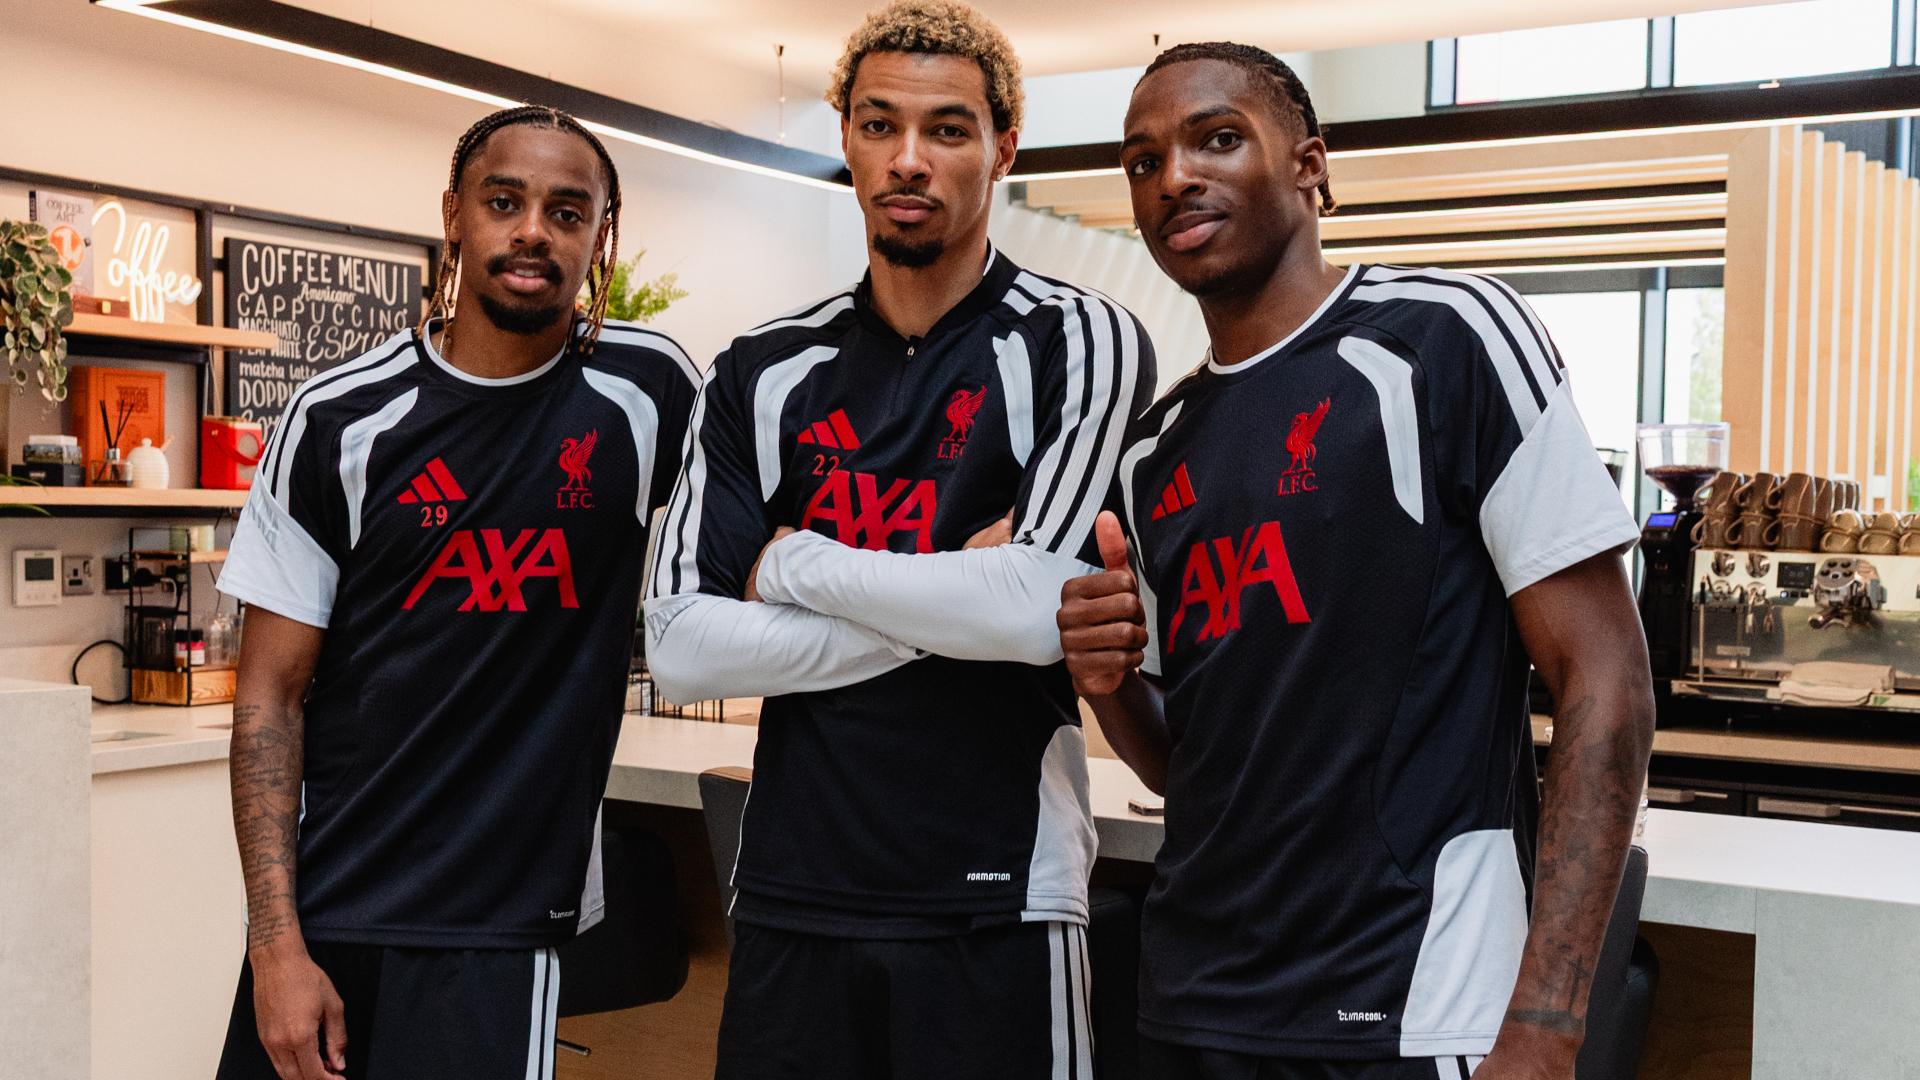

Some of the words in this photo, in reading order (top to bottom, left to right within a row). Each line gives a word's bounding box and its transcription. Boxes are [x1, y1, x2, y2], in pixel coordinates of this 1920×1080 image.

[242, 243, 332, 295] COFFEE
[298, 281, 357, 304] Americano
[237, 293, 407, 331] CAPPUCCINO
[239, 360, 285, 379] matcha
[812, 453, 840, 477] 22
[420, 505, 448, 528] 29
[801, 469, 938, 554] AXA
[401, 528, 580, 612] AXA
[1168, 521, 1312, 654] AXA
[966, 872, 1011, 881] FORMOTION
